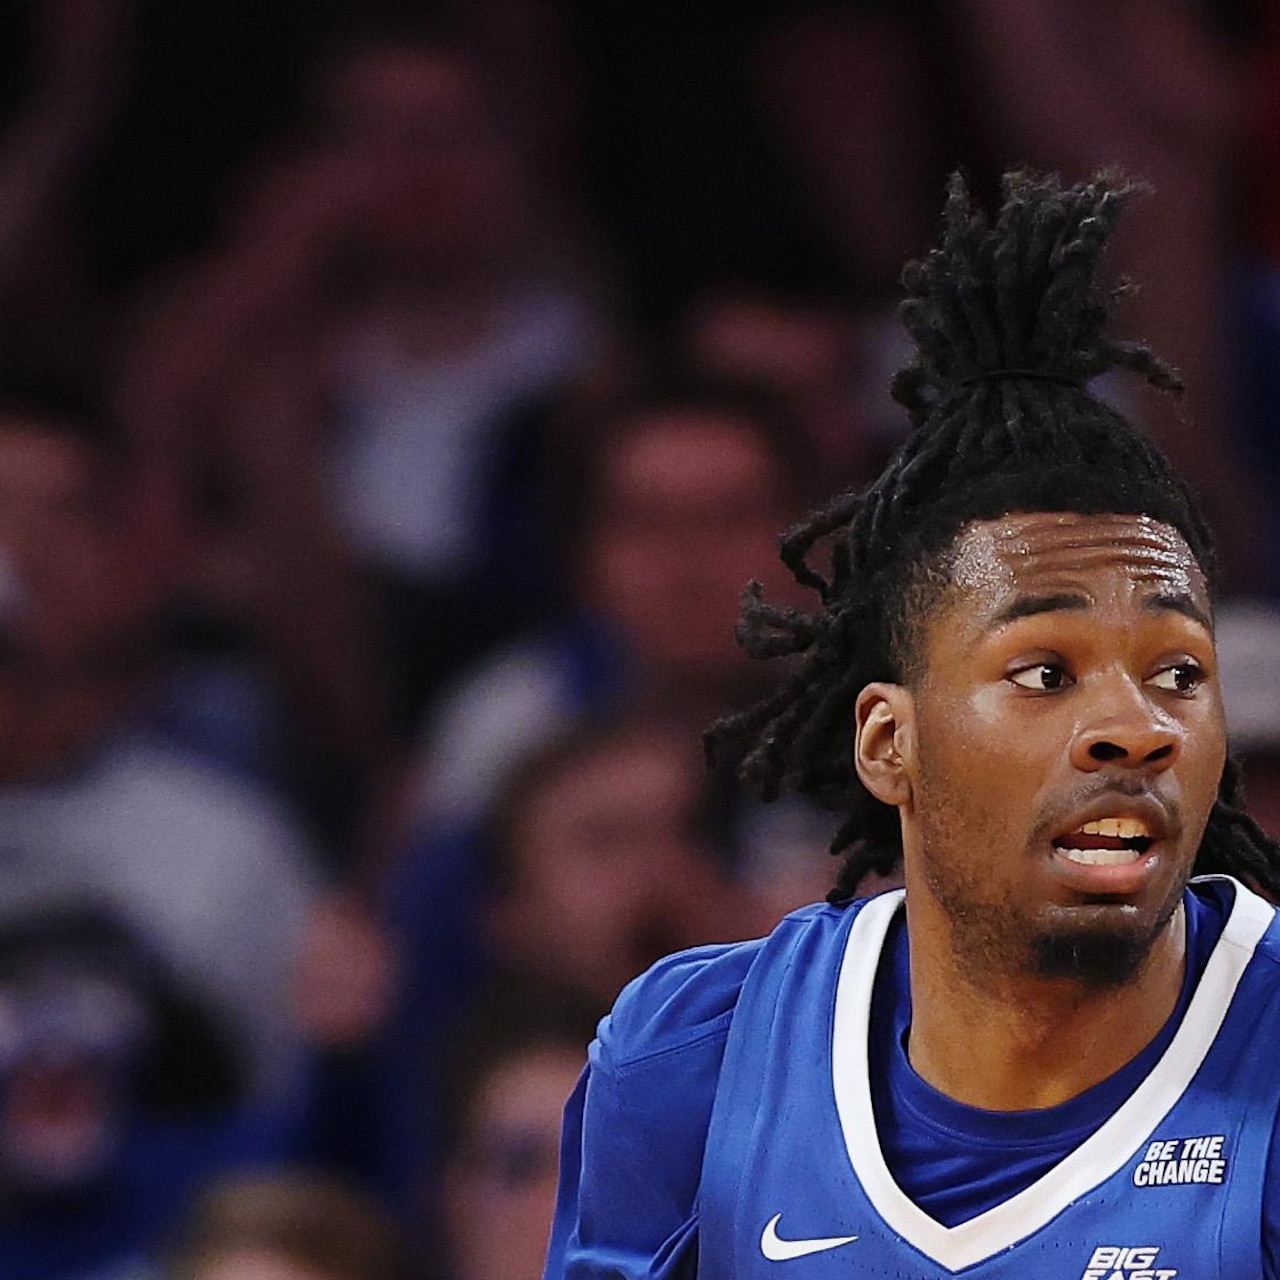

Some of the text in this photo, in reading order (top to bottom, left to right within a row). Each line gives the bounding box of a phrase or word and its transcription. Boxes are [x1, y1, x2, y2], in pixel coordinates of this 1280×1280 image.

[1144, 1136, 1225, 1161] BE THE
[1133, 1159, 1226, 1186] CHANGE
[1087, 1247, 1160, 1270] BIG
